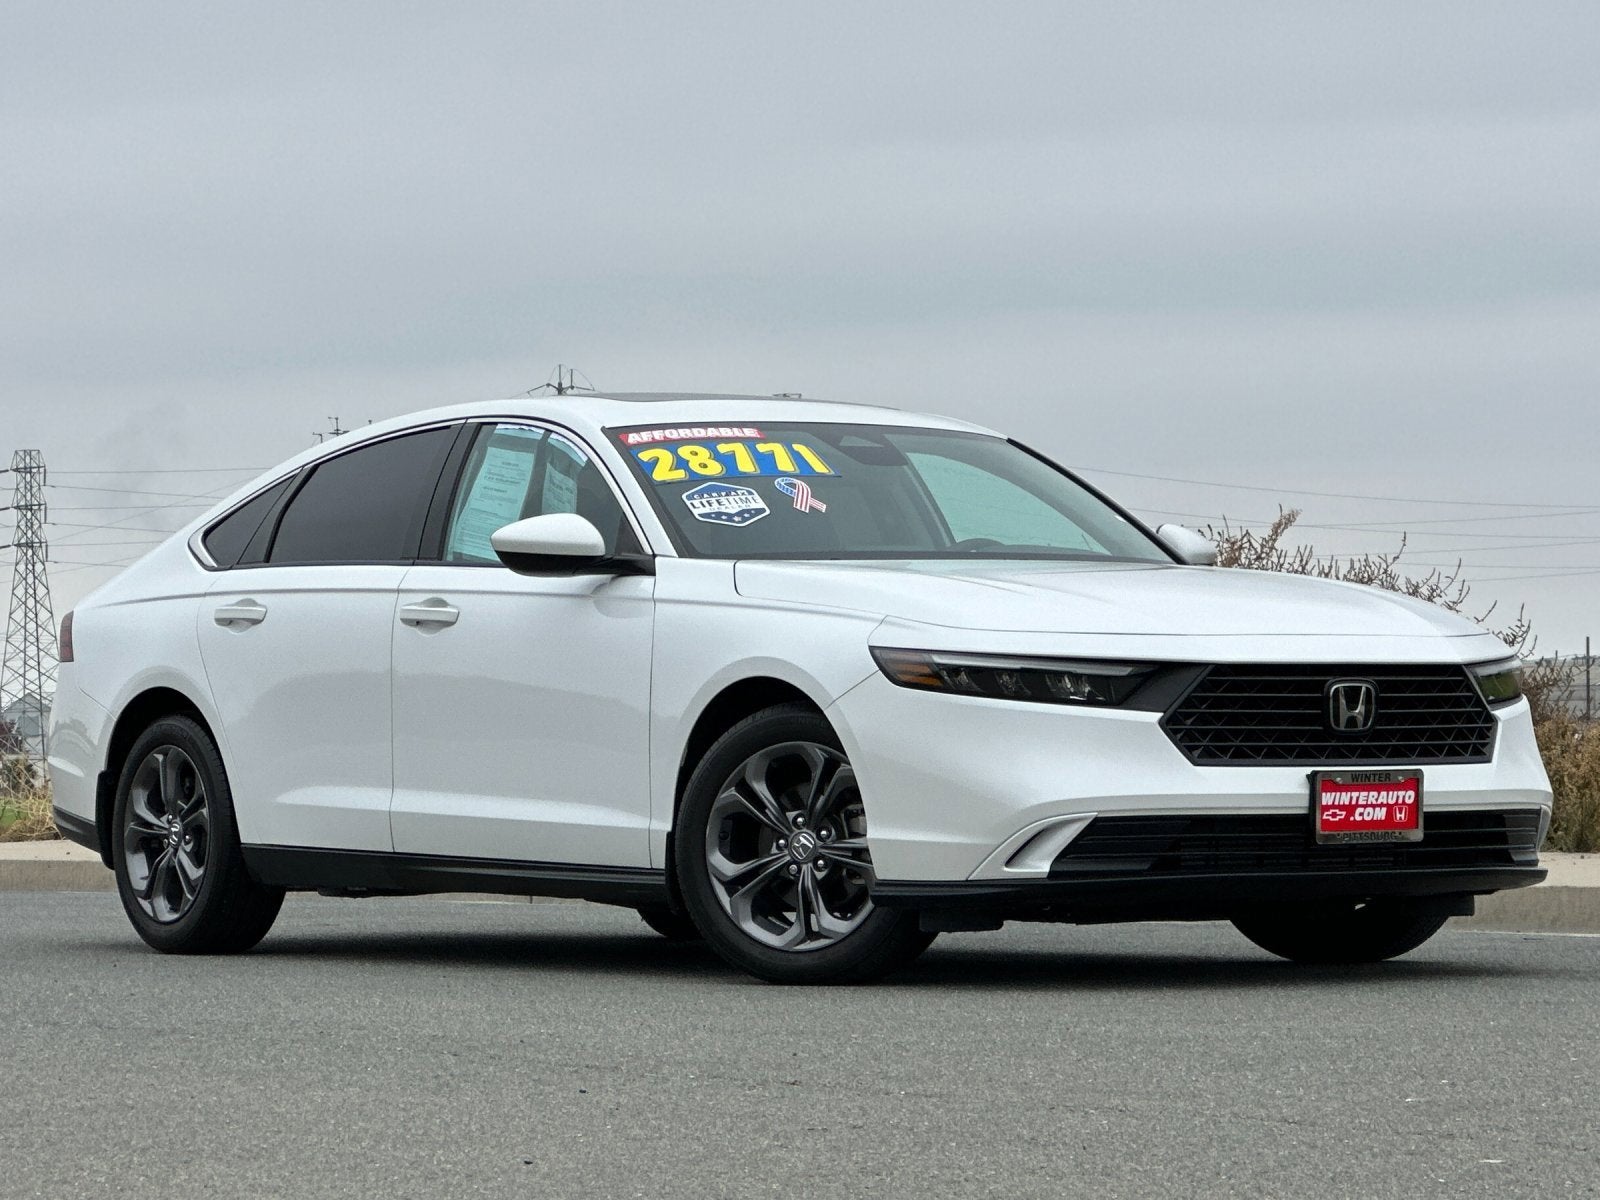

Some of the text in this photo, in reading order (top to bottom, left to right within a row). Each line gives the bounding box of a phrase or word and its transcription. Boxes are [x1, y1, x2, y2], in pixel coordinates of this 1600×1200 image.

[637, 443, 832, 482] 28771
[693, 490, 748, 500] CARFAX
[690, 496, 760, 509] LIFETIME
[1351, 773, 1391, 782] WINTER
[1321, 791, 1415, 805] WINTERAUTO
[1350, 807, 1387, 821] .COM
